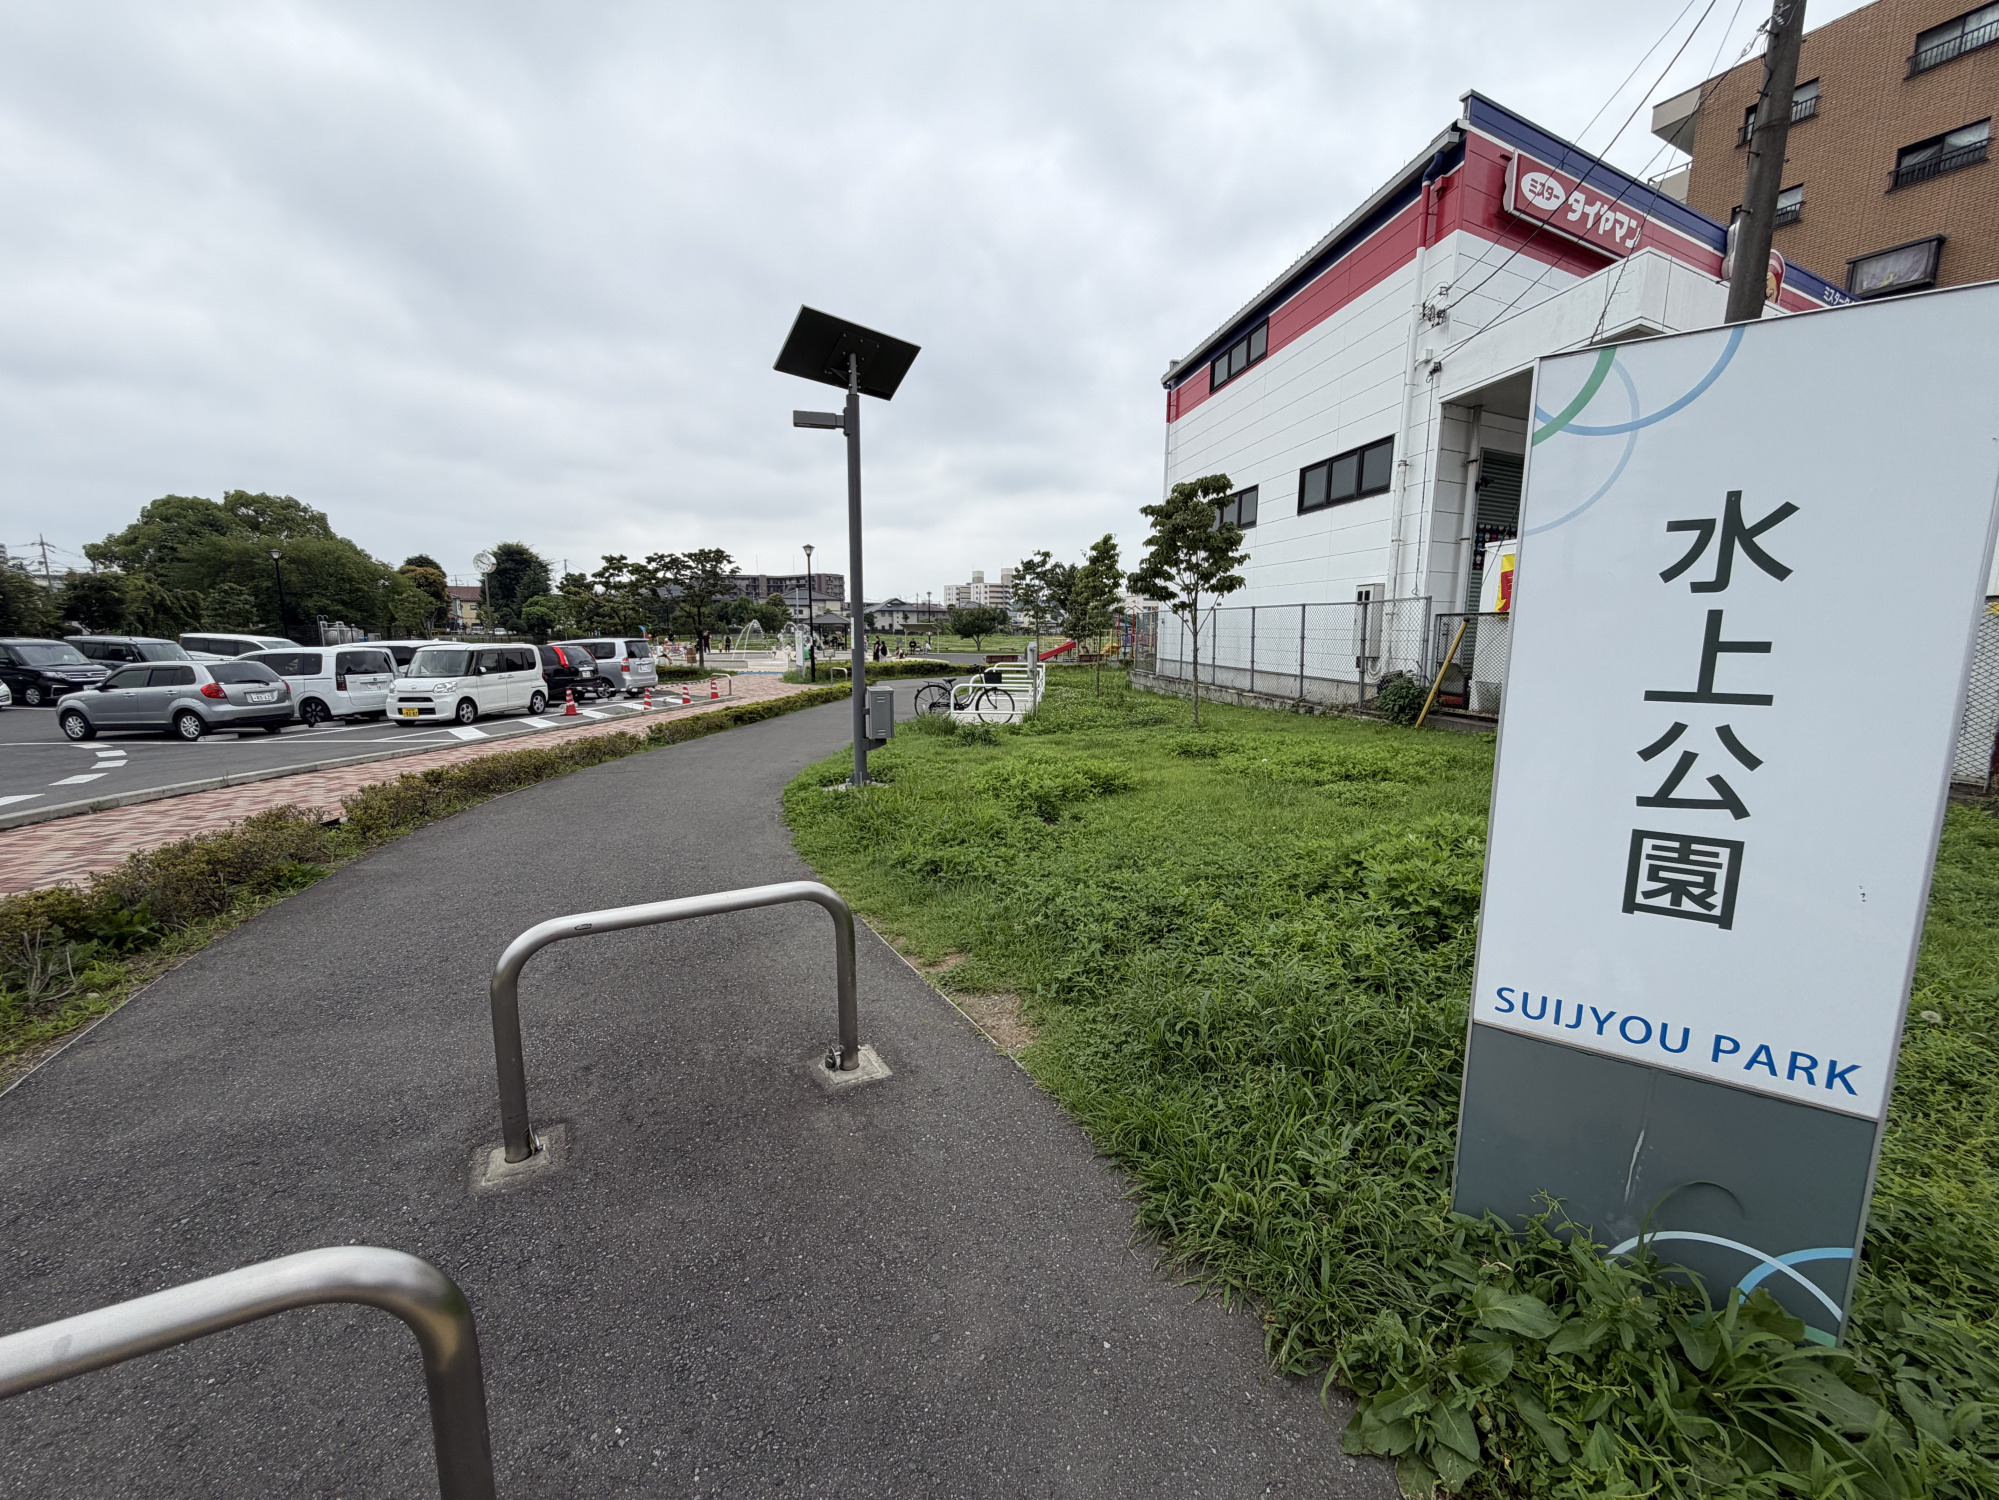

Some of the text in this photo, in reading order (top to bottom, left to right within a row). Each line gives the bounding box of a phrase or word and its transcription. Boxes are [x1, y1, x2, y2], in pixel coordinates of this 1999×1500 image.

[1528, 177, 1561, 202] ミスター
[1622, 490, 1800, 930] 水上公園
[1494, 987, 1862, 1097] SUIJYOU PARK
